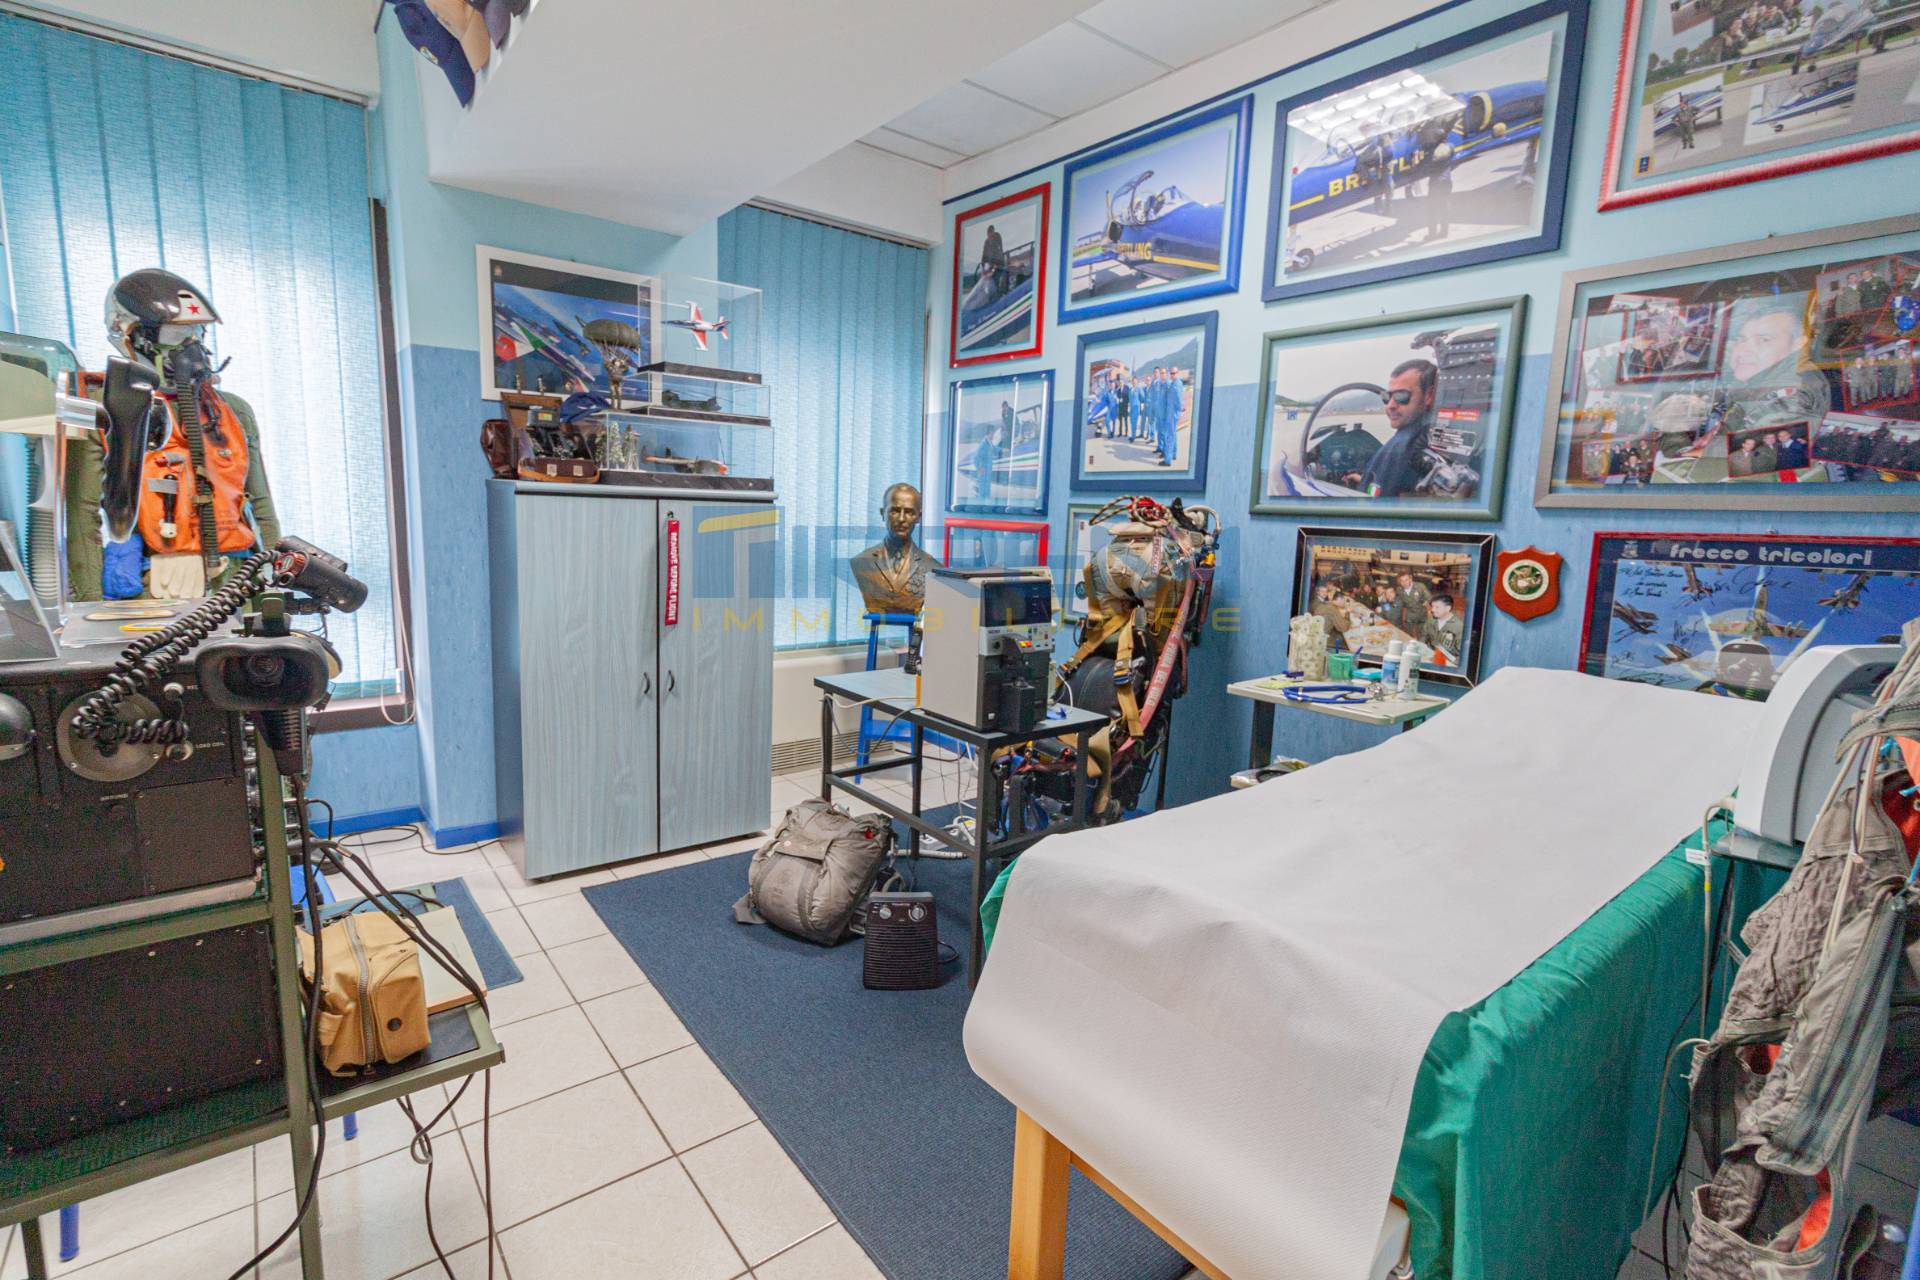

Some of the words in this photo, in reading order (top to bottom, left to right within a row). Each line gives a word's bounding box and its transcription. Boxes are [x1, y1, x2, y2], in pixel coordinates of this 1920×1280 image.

[670, 532, 678, 564] REMOVE
[1670, 544, 1749, 561] frecce
[1758, 546, 1873, 566] tricolori
[670, 565, 678, 593] BEFORE
[668, 595, 678, 621] FLIGHT
